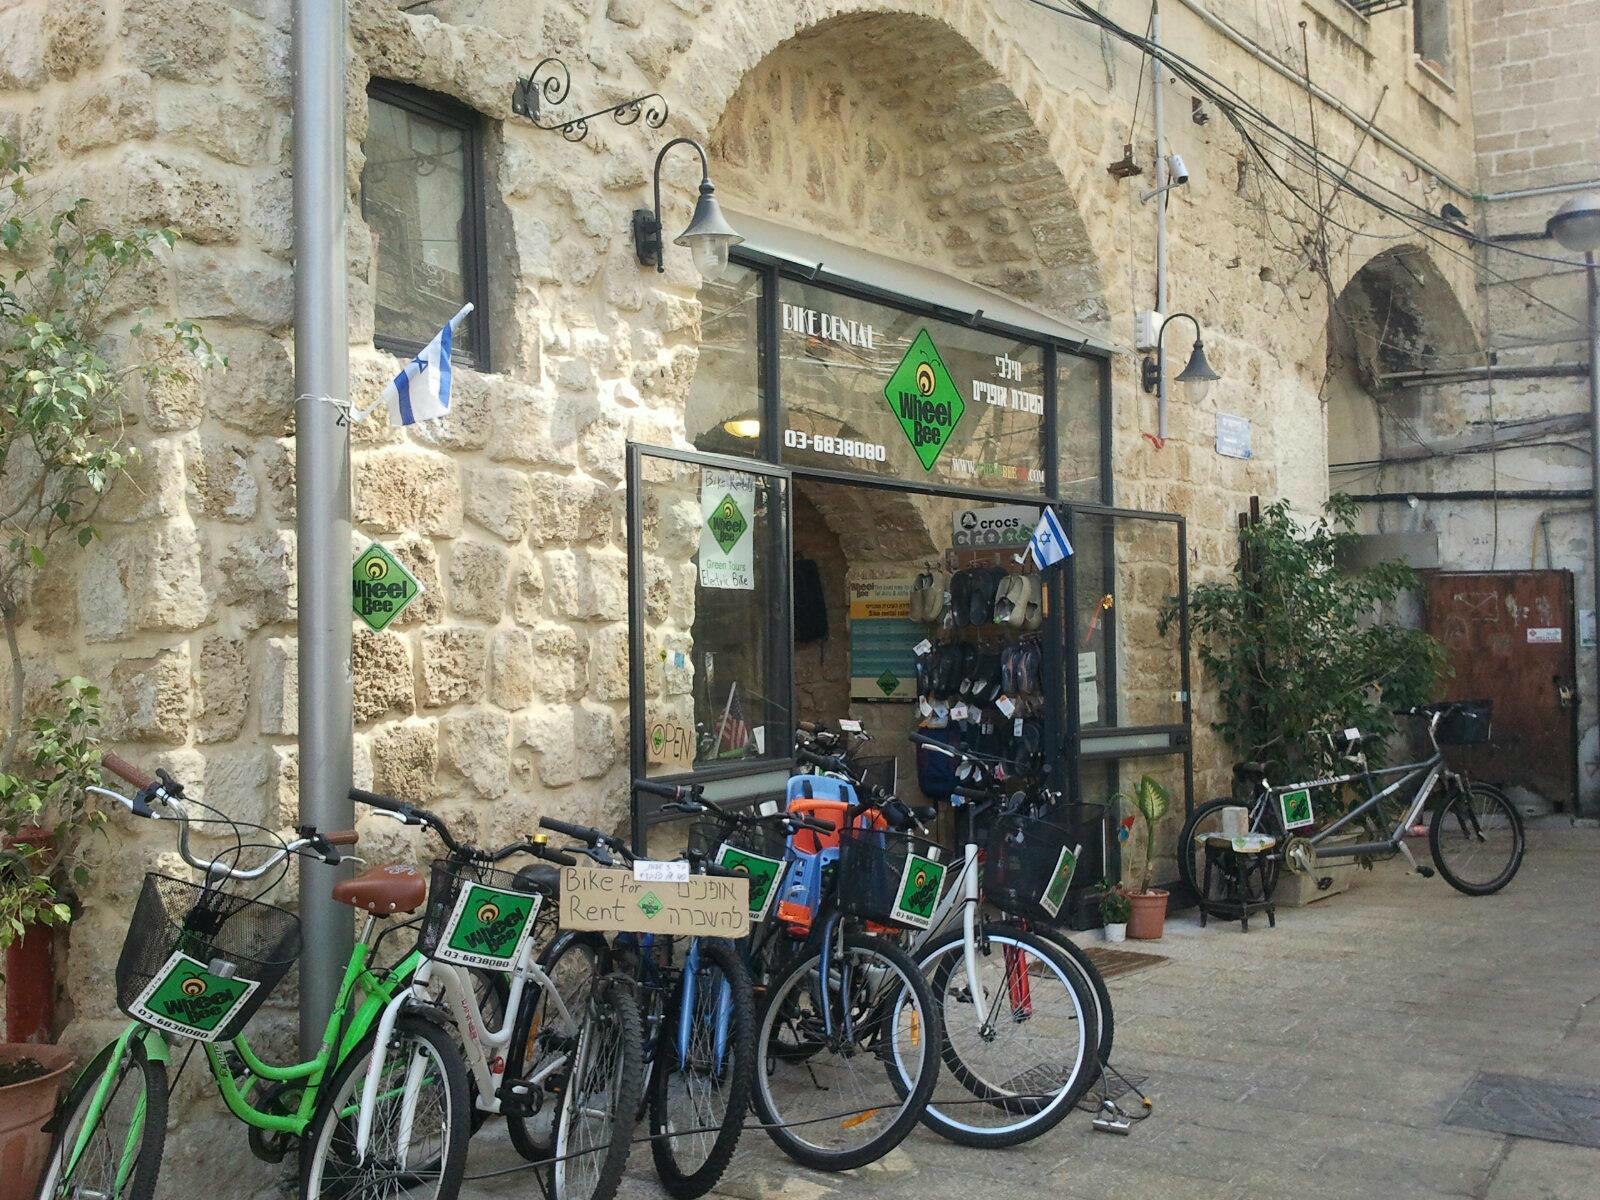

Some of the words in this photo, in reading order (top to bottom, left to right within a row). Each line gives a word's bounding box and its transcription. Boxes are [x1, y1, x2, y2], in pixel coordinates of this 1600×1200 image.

[782, 303, 818, 336] BIKE
[820, 312, 877, 350] RENTAL
[972, 379, 1008, 407] אופניים
[898, 391, 953, 427] Wheel
[784, 429, 886, 462] 03-6838080
[913, 420, 941, 447] Bee
[705, 470, 726, 489] Bike
[712, 517, 742, 533] Wheel
[980, 517, 1020, 530] crocs
[706, 559, 727, 570] Green
[728, 561, 746, 571] Tours
[732, 572, 748, 586] Bike
[361, 596, 394, 616] Bee
[651, 723, 692, 761] OPEN
[566, 867, 613, 892] Bike
[620, 873, 642, 894] for
[569, 895, 626, 922] Rent
[668, 906, 743, 929] להשכרה
[444, 949, 510, 968] 03-6838080
[138, 1008, 209, 1039] 03-6838080
